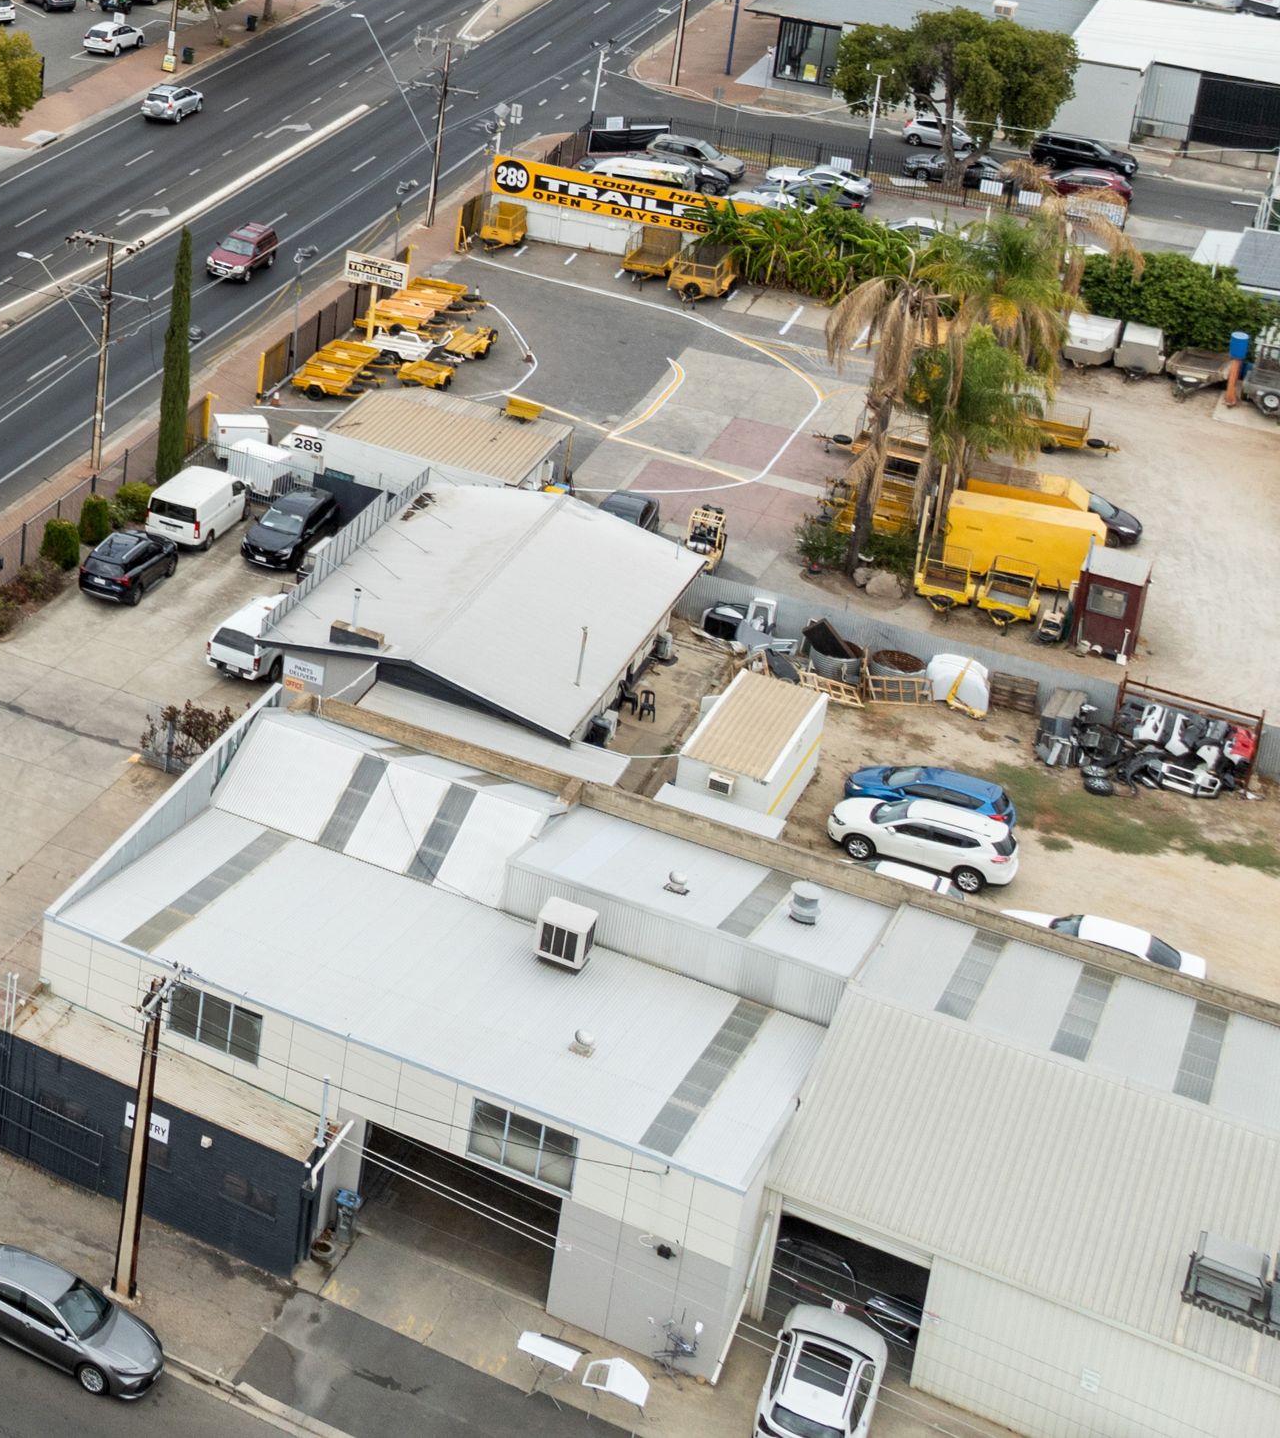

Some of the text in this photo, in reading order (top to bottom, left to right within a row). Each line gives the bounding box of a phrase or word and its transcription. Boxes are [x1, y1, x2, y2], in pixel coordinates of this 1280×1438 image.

[496, 165, 528, 189] 289
[591, 178, 657, 197] cooks
[532, 191, 582, 208] OPEN
[592, 203, 601, 212] 7
[611, 207, 661, 224] DAYS
[540, 175, 708, 222] TRAILE
[350, 262, 402, 281] TRAILERS
[294, 437, 323, 453] 289
[288, 669, 318, 682] DELIVERY
[294, 664, 314, 675] PARTS
[285, 679, 304, 691] OFFICE
